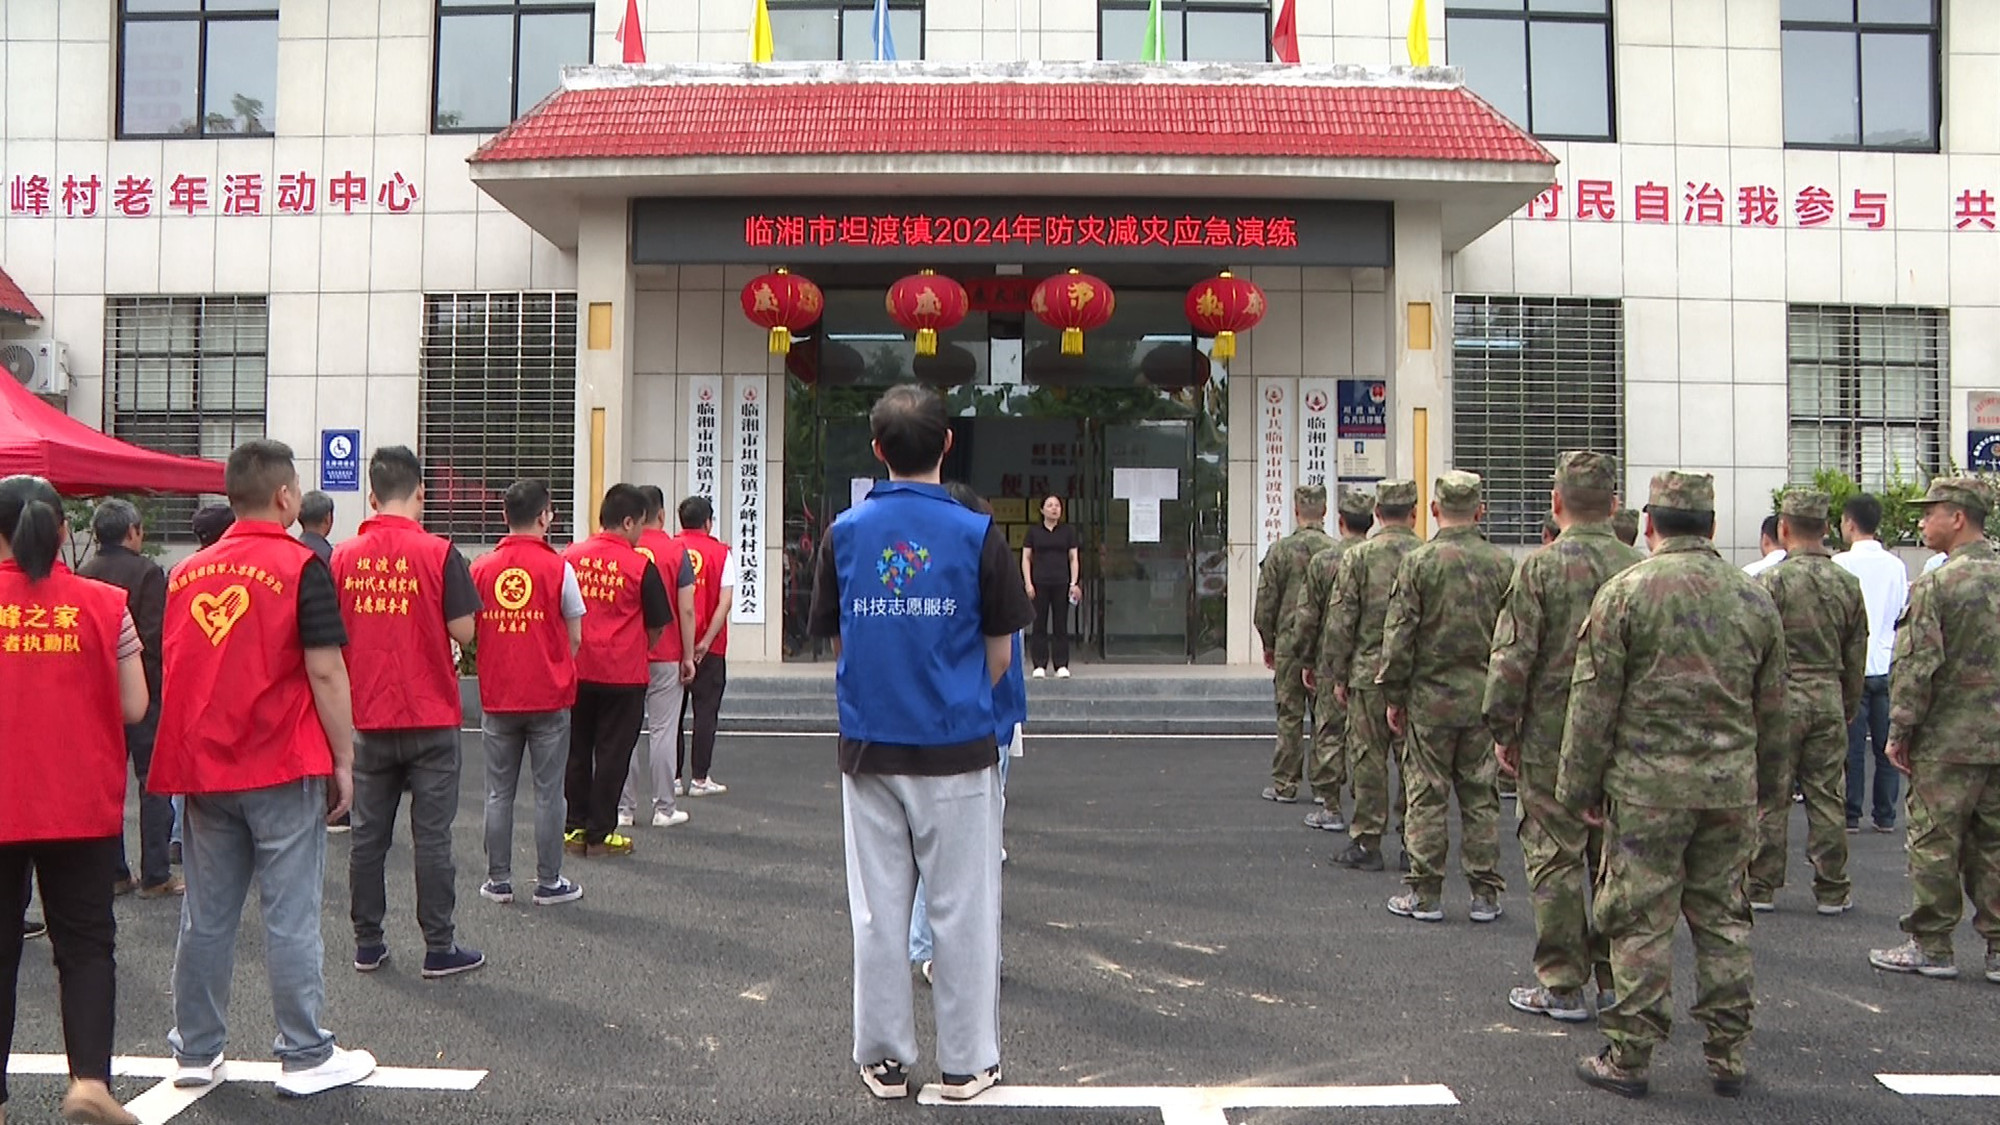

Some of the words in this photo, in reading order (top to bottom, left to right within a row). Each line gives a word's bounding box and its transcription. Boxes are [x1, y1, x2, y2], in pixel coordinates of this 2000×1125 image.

[10, 171, 418, 216] 峰村老年活动中心
[1526, 178, 1888, 229] 村民自治我参与
[1955, 189, 1996, 230] 共
[745, 214, 1298, 248] 临湘市坦渡镇2024年防灾减灾应急演练
[739, 403, 760, 614] 临湘市坦渡镇万峰村村民委员会
[853, 597, 957, 617] 科技志愿服务
